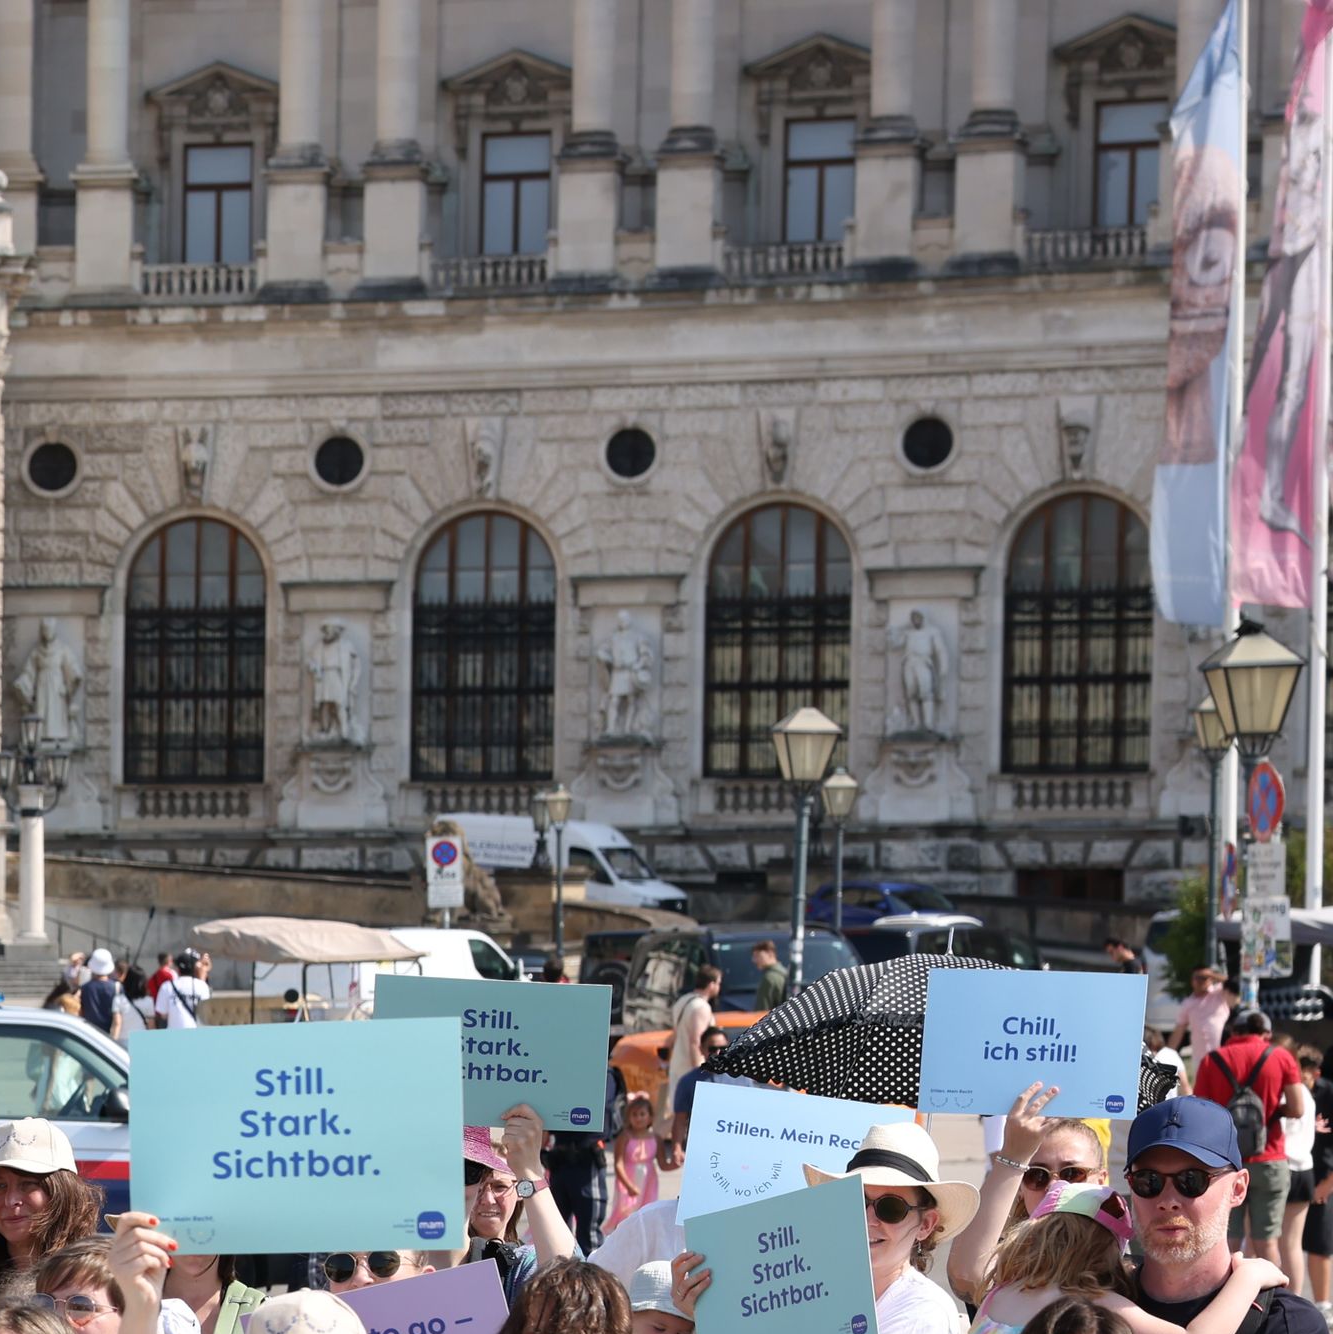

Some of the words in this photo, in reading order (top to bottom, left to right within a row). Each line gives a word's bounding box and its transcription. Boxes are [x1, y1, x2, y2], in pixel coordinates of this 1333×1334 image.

[463, 1008, 520, 1030] Still.
[1003, 1016, 1061, 1039] Chill,
[984, 1041, 1019, 1061] ich
[1026, 1042, 1077, 1063] still!
[255, 1066, 335, 1097] Still.
[462, 1062, 548, 1084] htbar.
[240, 1108, 351, 1138] Stark.
[716, 1119, 775, 1140] Stillen.
[780, 1127, 824, 1146] Mein
[828, 1133, 863, 1150] Rec
[212, 1149, 381, 1180] Sichtbar.
[710, 1151, 721, 1169] Ich
[770, 1159, 783, 1181] will.
[712, 1171, 731, 1193] still,
[734, 1188, 752, 1197] wo
[754, 1181, 773, 1195] ich
[758, 1225, 800, 1254] Still.
[753, 1254, 811, 1285] Stark.
[741, 1281, 829, 1317] Sichtbar.
